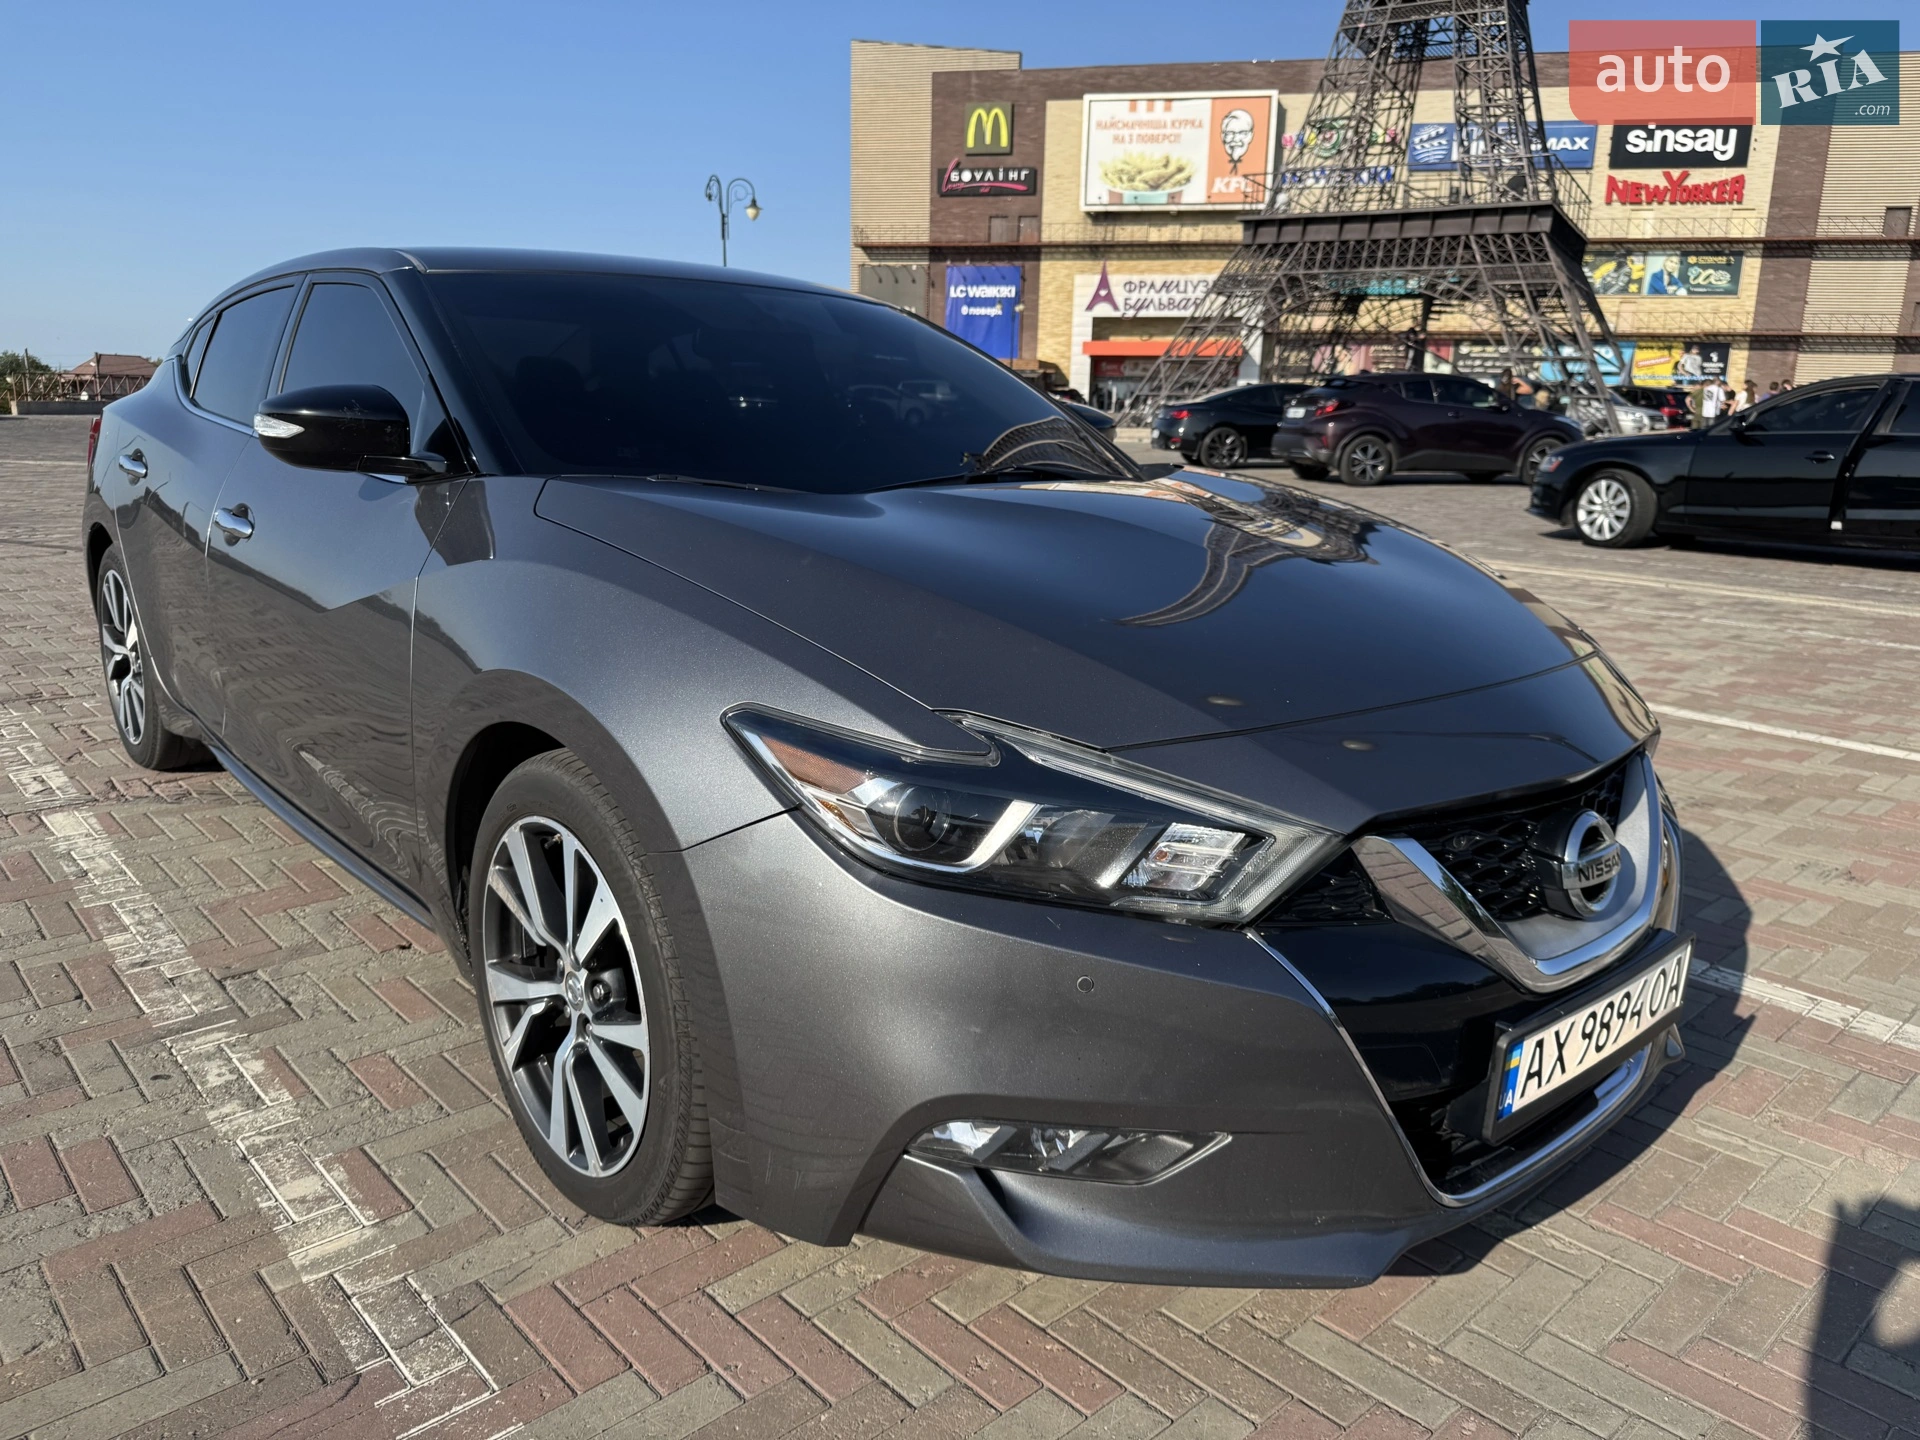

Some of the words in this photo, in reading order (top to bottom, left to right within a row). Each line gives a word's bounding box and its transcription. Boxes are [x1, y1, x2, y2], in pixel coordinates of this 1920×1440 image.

[1170, 118, 1204, 129] КУРКА
[1112, 133, 1126, 144] НА
[1541, 136, 1590, 151] MAX
[1625, 122, 1738, 161] sinsay
[1211, 177, 1253, 194] KFC
[949, 285, 967, 298] LC
[1123, 280, 1214, 294] ФРАНЦУЗ
[1519, 1020, 1576, 1099] AX
[1577, 979, 1648, 1065] 9894
[1650, 955, 1683, 1018] OA
